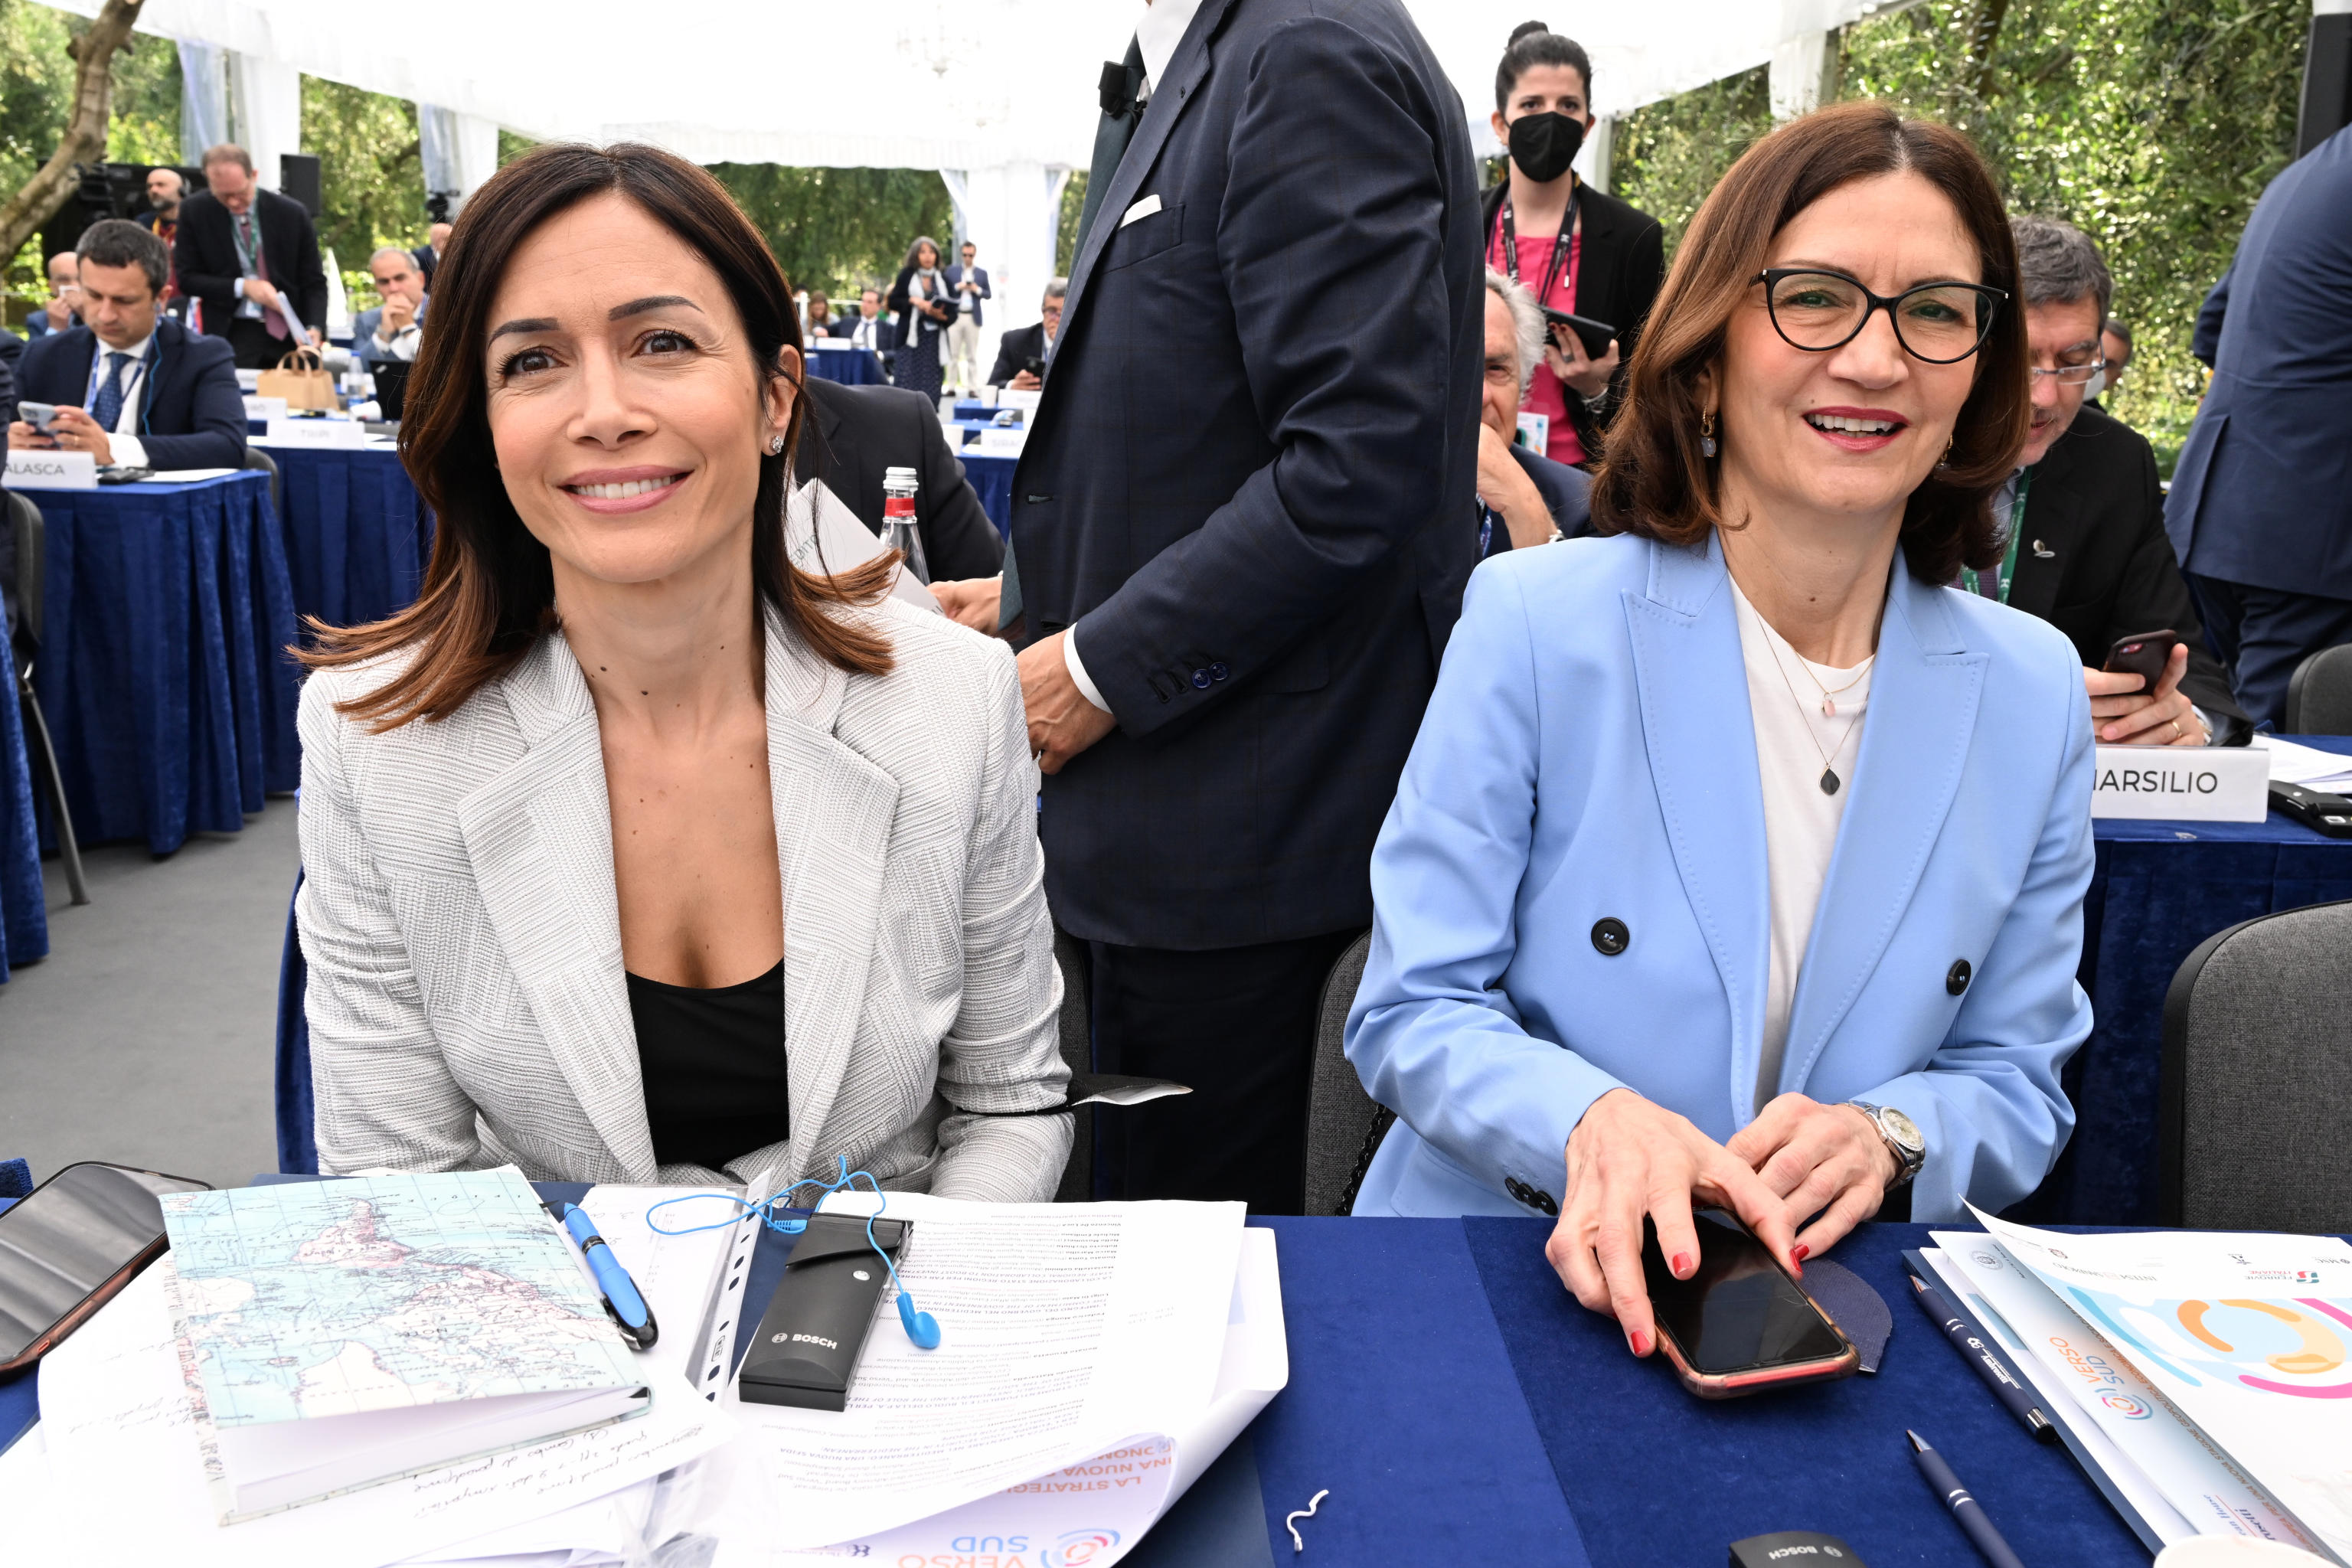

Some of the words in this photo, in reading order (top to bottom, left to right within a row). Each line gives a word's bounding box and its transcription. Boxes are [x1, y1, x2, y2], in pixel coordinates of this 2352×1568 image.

[2093, 769, 2218, 794] ARSILIO
[792, 1334, 838, 1350] BOSCH
[2049, 1331, 2101, 1386] VERSO
[2085, 1351, 2124, 1390] SUD
[2186, 1426, 2224, 1463] STAGIONE
[1063, 1463, 1132, 1475] NUOVA
[2220, 1459, 2249, 1486] NUOVA
[998, 1480, 1109, 1494] STRATEGI
[1115, 1475, 1140, 1487] LA
[951, 1535, 1029, 1552] SUD
[1768, 1545, 1818, 1560] BOSCH
